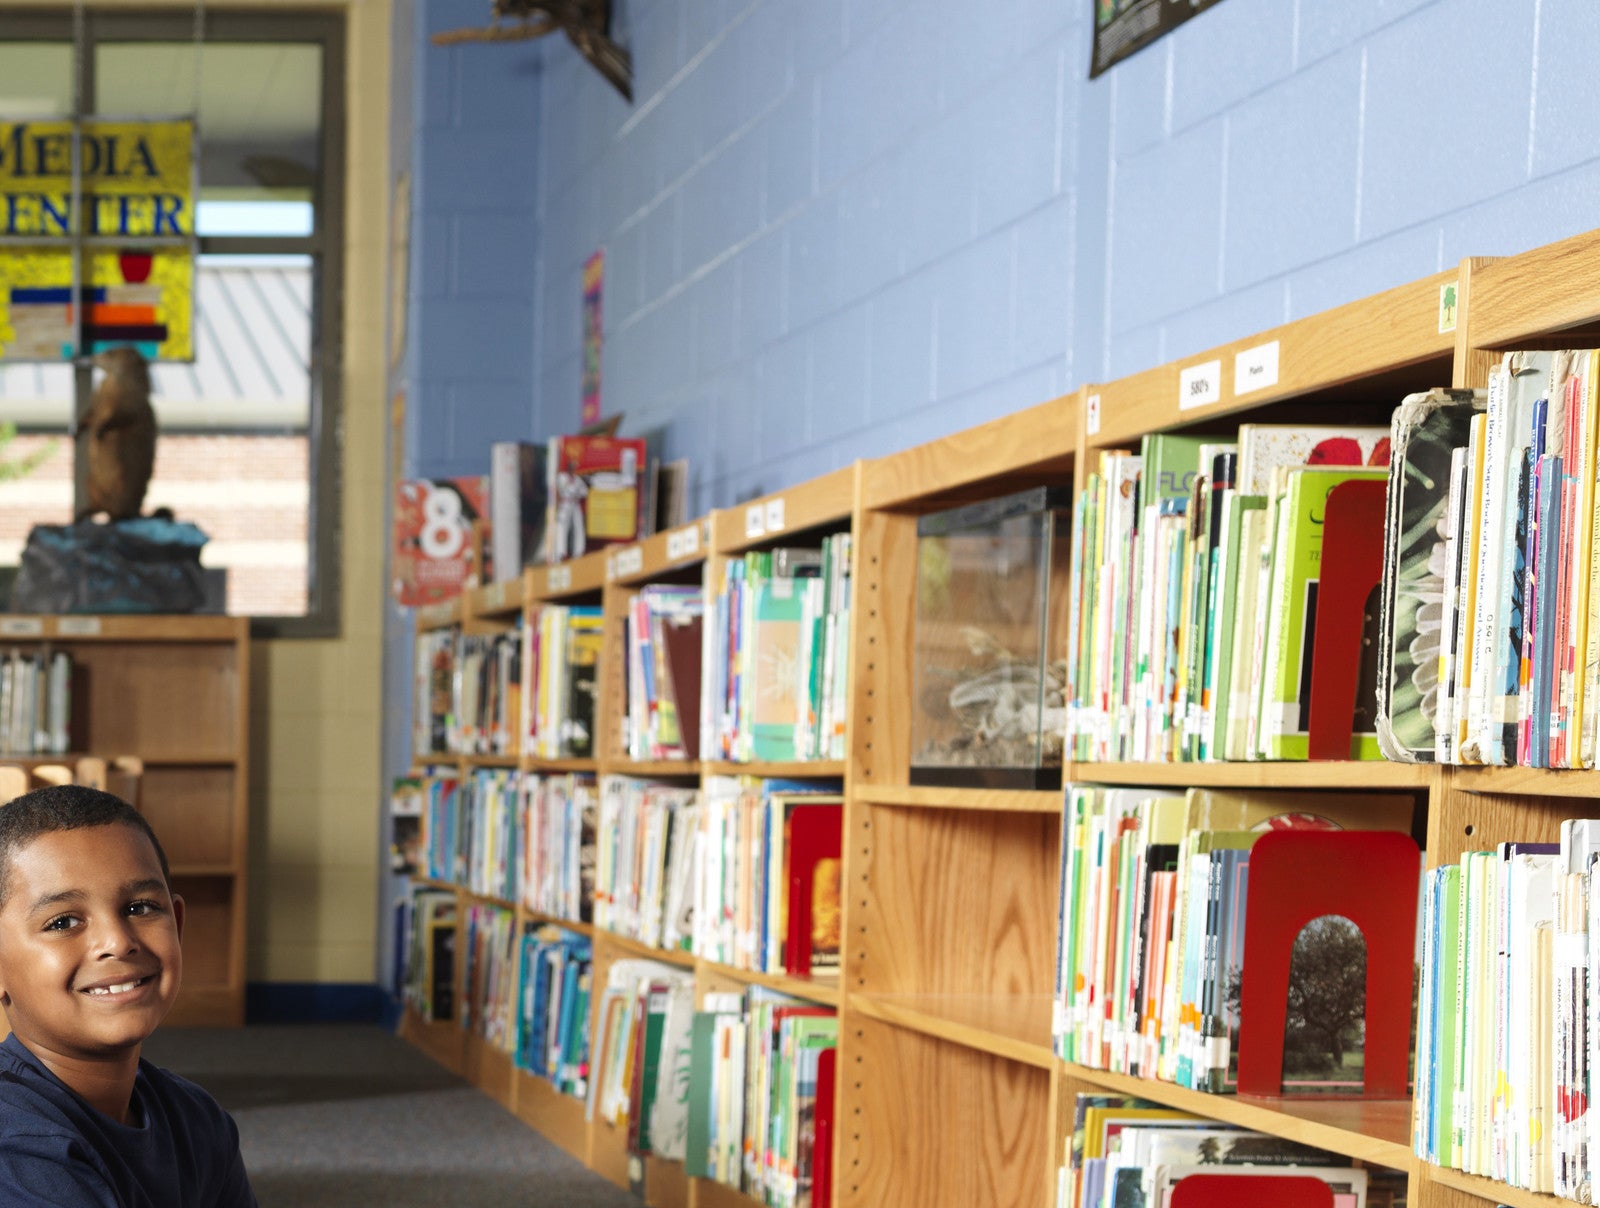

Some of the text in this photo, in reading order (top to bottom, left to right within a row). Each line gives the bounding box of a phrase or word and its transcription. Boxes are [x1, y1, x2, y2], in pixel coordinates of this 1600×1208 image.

[1190, 379, 1209, 396] 580's
[1489, 376, 1498, 416] Charlie
[1486, 418, 1496, 462] Brown's
[1484, 465, 1493, 500] Super
[1483, 499, 1492, 527] Book
[1479, 544, 1488, 601] Questions
[1474, 627, 1482, 672] Answers
